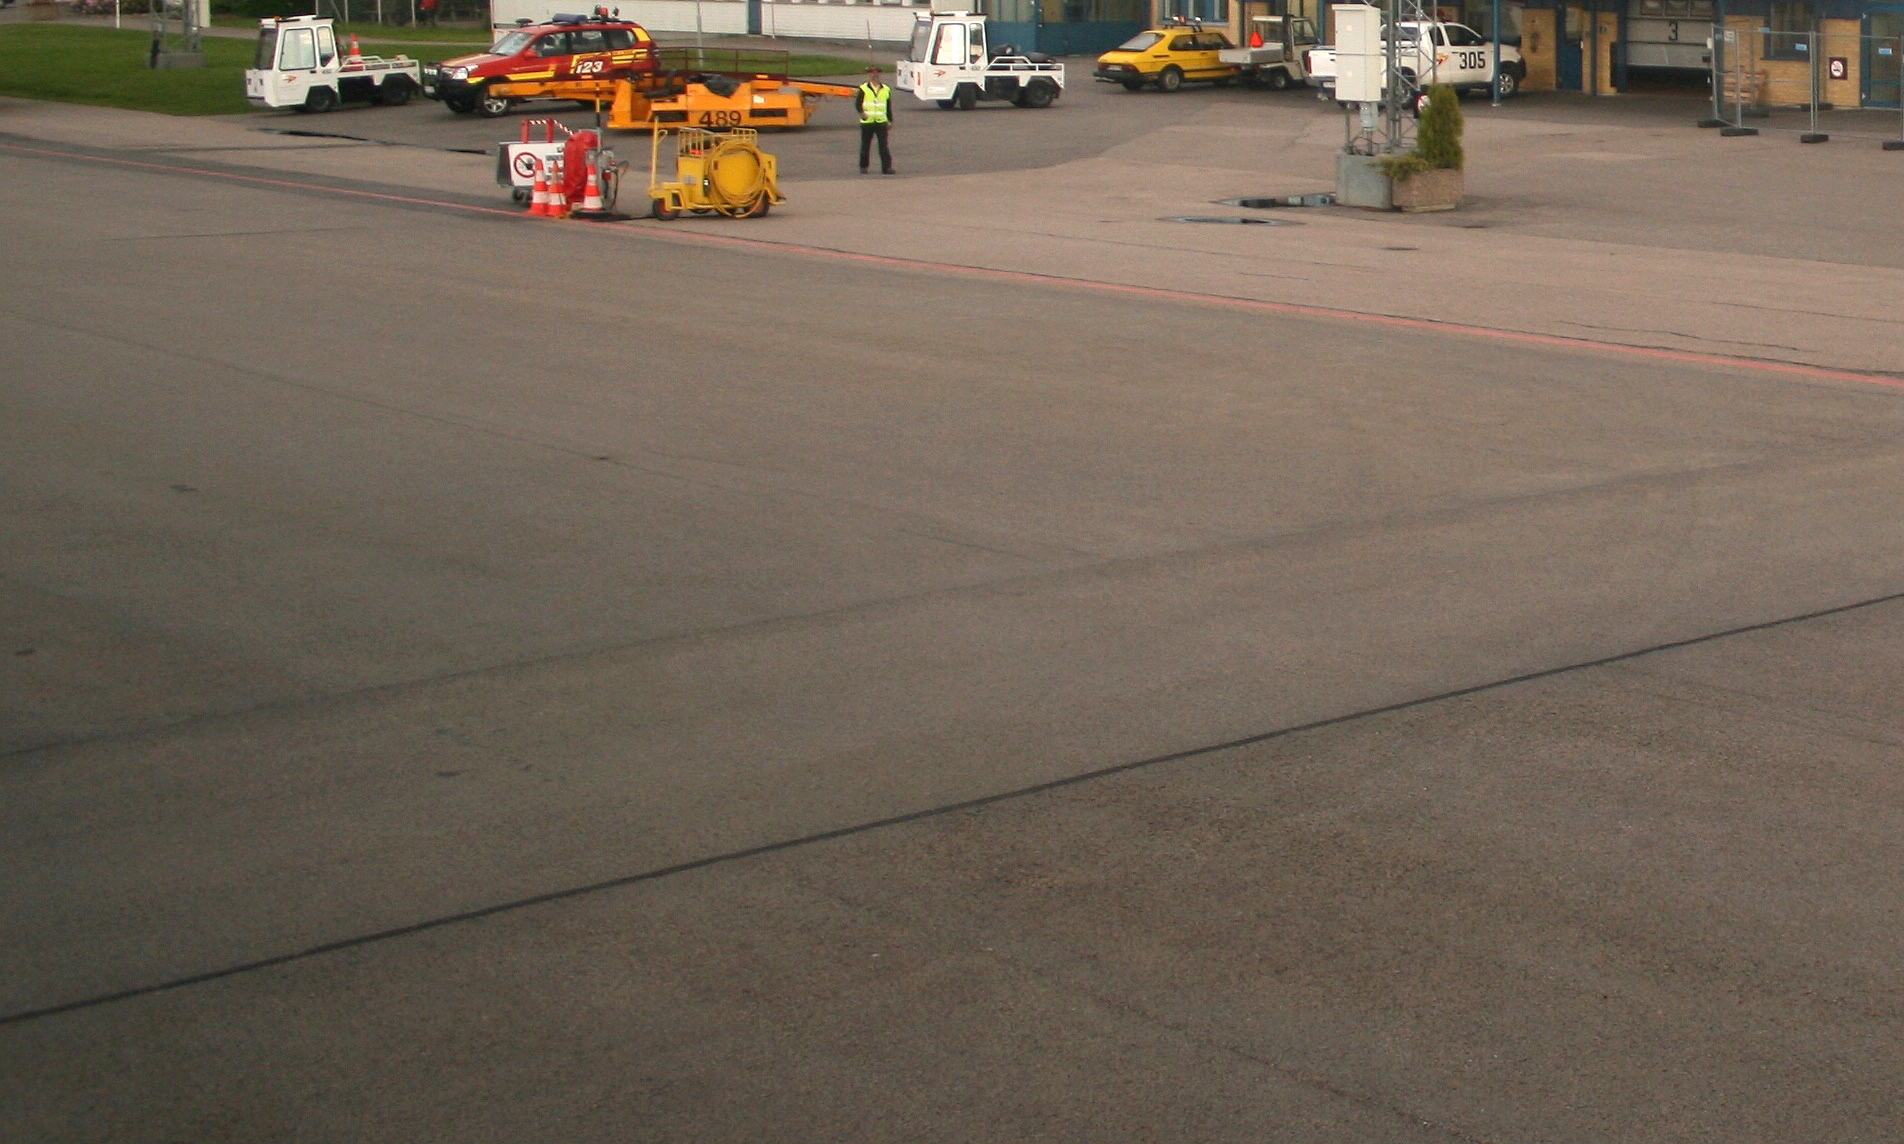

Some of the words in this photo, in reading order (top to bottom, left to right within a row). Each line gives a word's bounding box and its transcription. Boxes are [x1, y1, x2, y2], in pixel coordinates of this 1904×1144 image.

[1669, 19, 1678, 40] 3
[576, 61, 603, 74] 123
[1460, 51, 1485, 69] 305
[699, 110, 742, 127] 489
